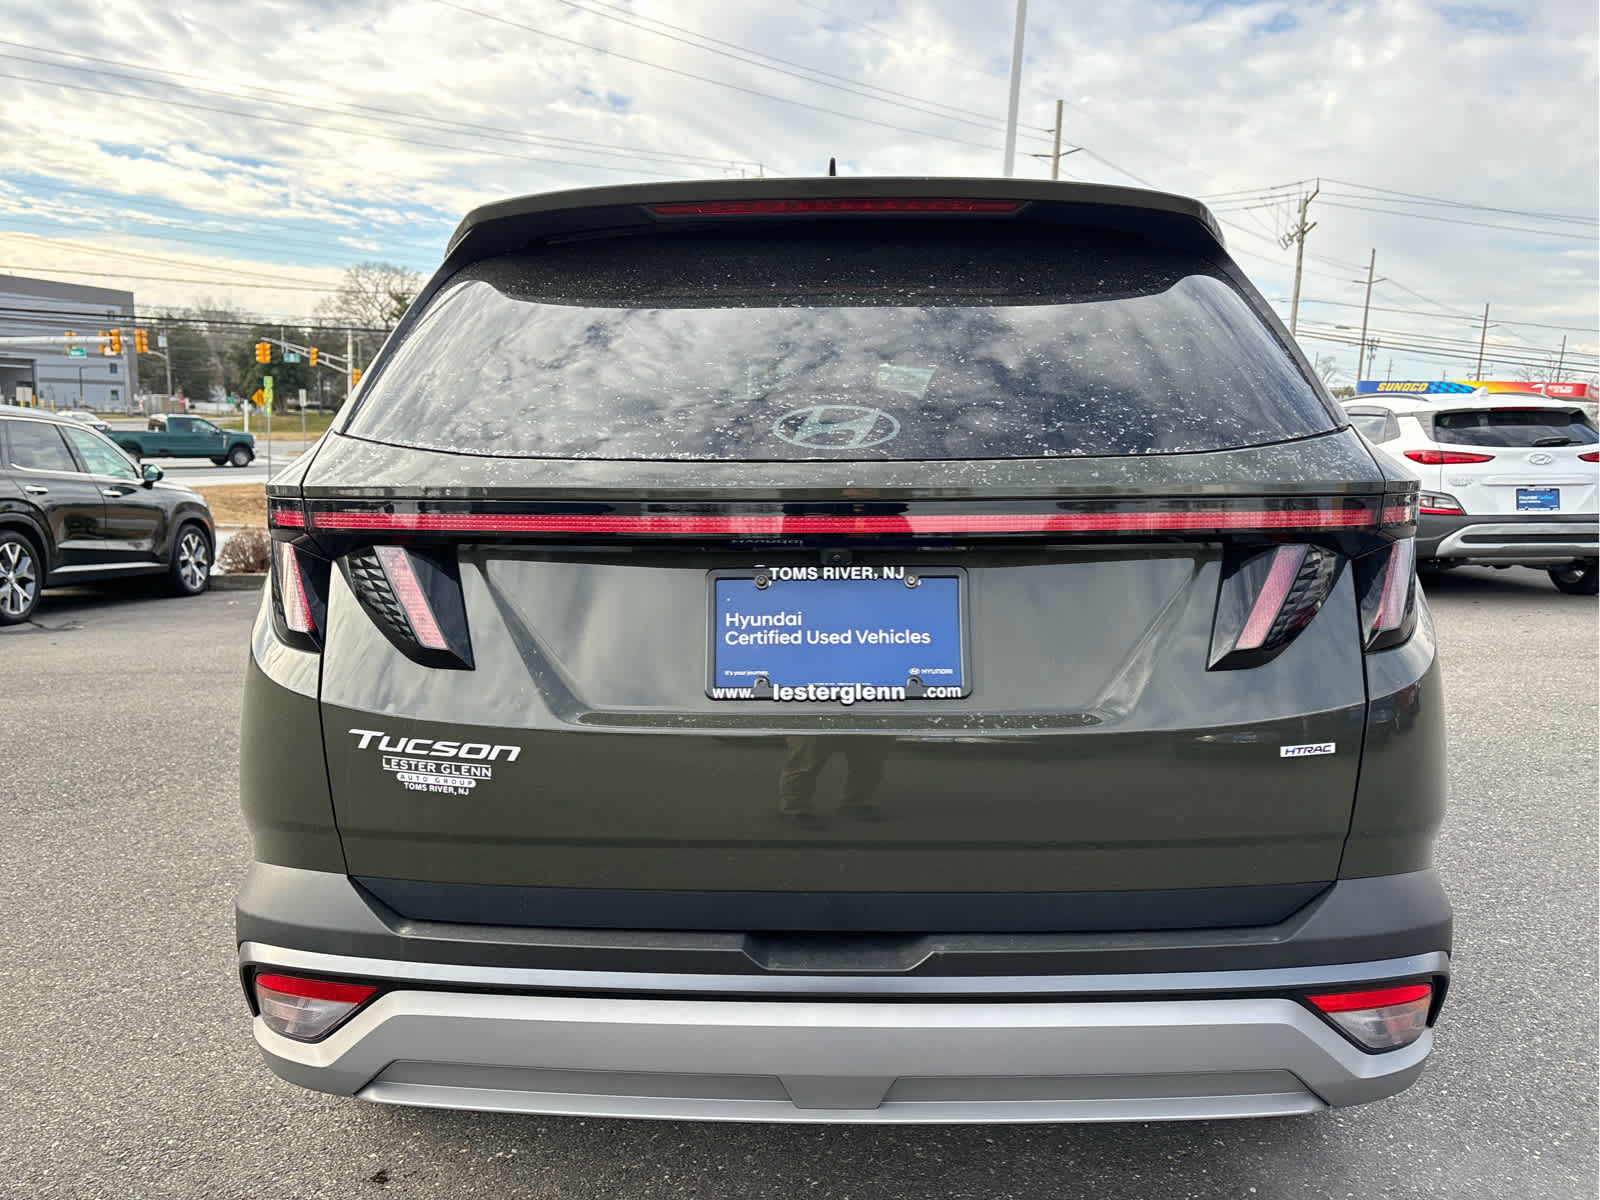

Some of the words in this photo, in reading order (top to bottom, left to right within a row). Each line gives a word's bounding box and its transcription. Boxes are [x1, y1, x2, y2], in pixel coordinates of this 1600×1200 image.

[1376, 382, 1429, 392] SUNOCO
[769, 566, 818, 580] TOMS
[823, 566, 878, 580] RIVER,
[883, 566, 904, 579] NJ
[725, 611, 803, 630] Hyundai
[725, 630, 802, 646] Certified
[806, 629, 852, 645] Used
[856, 628, 931, 645] Vehicles
[712, 687, 755, 699] www.
[773, 683, 906, 705] lesterglenn
[922, 686, 962, 698] .com
[1284, 744, 1332, 755] HTRAC
[382, 758, 437, 773] LESTER
[440, 763, 492, 777] GLENN
[399, 774, 428, 782] AUTO
[435, 777, 473, 786] GROUP
[404, 782, 427, 792] TOMS
[429, 785, 457, 795] RIVER,
[458, 787, 469, 796] NJ
